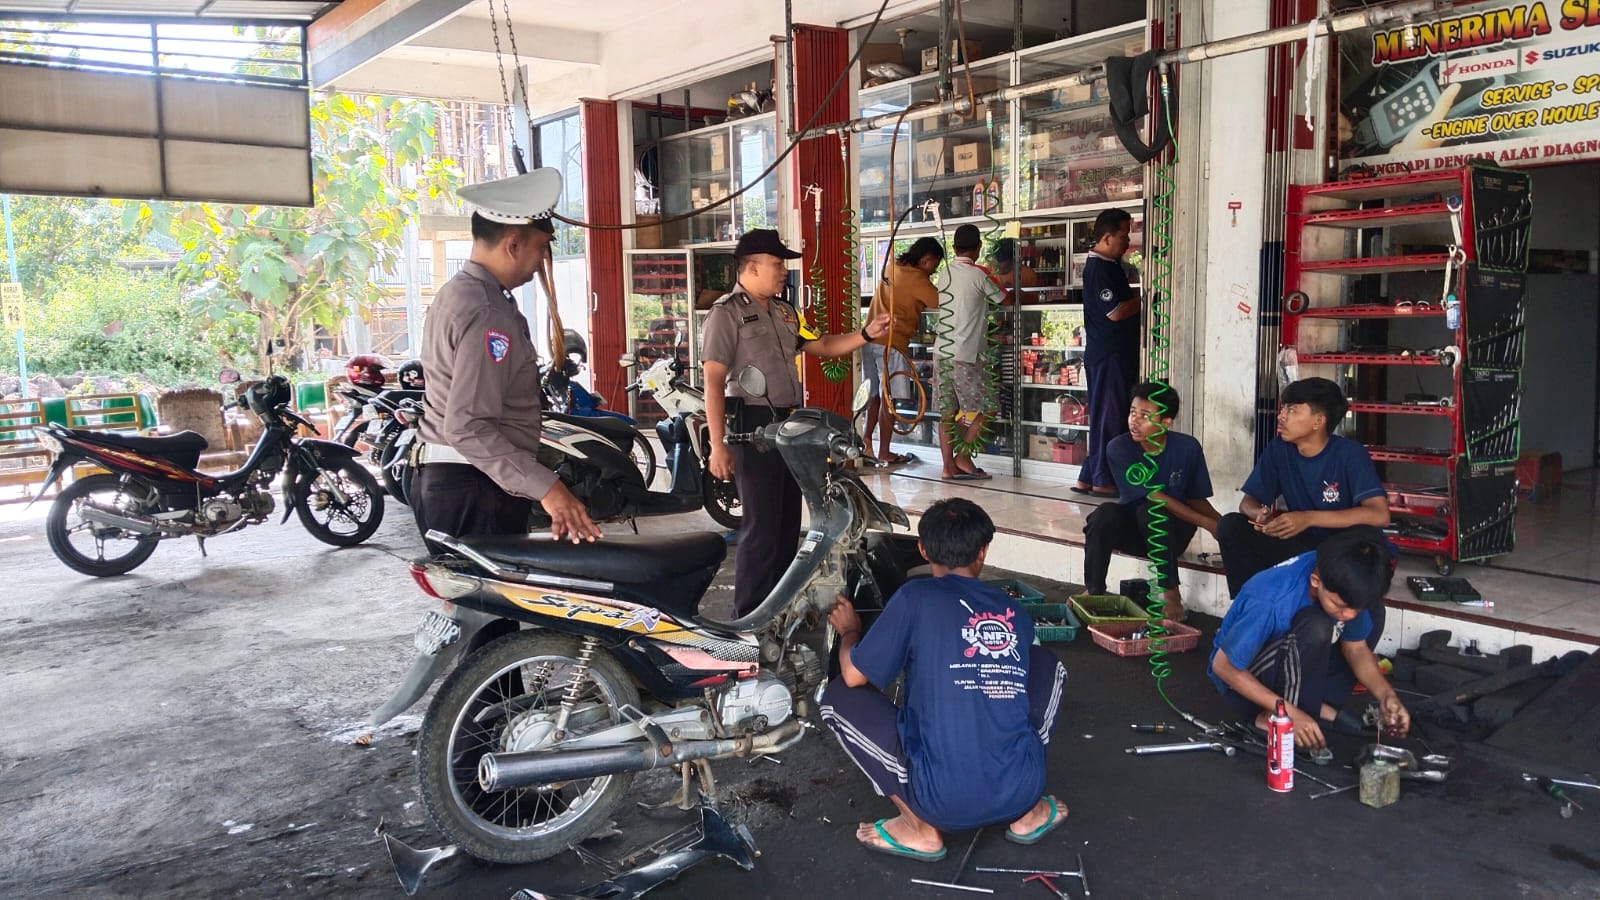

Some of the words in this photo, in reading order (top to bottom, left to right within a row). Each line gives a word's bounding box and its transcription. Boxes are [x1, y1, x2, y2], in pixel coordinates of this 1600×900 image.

[1373, 2, 1551, 66] MENERIMA
[1459, 58, 1515, 75] HONDA
[1482, 81, 1554, 107] SERVICE
[1573, 74, 1600, 95] SP
[1491, 109, 1538, 131] OVER
[1541, 101, 1600, 125] HOULE
[1500, 147, 1539, 161] ALAT
[1543, 140, 1600, 157] DIAGN
